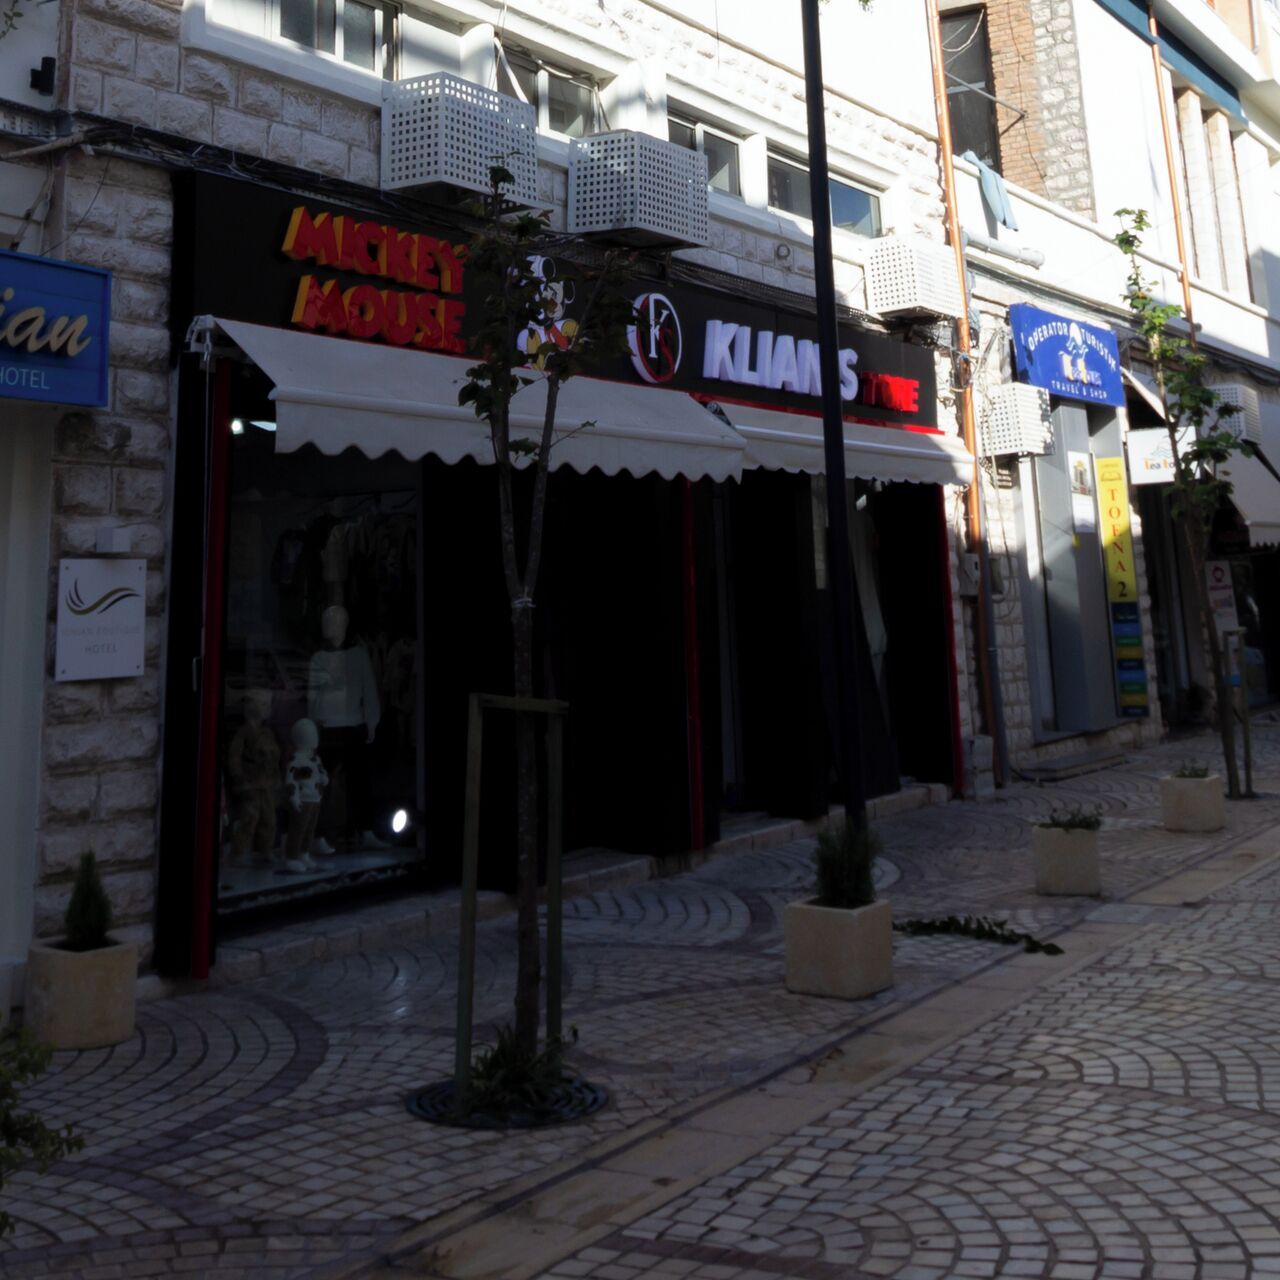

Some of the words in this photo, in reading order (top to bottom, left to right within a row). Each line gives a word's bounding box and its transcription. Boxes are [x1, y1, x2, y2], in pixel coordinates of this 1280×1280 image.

[281, 205, 470, 294] MICKEY
[290, 273, 467, 353] MOUSE
[1028, 321, 1069, 351] OPERATOR
[1081, 327, 1117, 373] TURISTIK
[1051, 380, 1080, 395] TRAVEL
